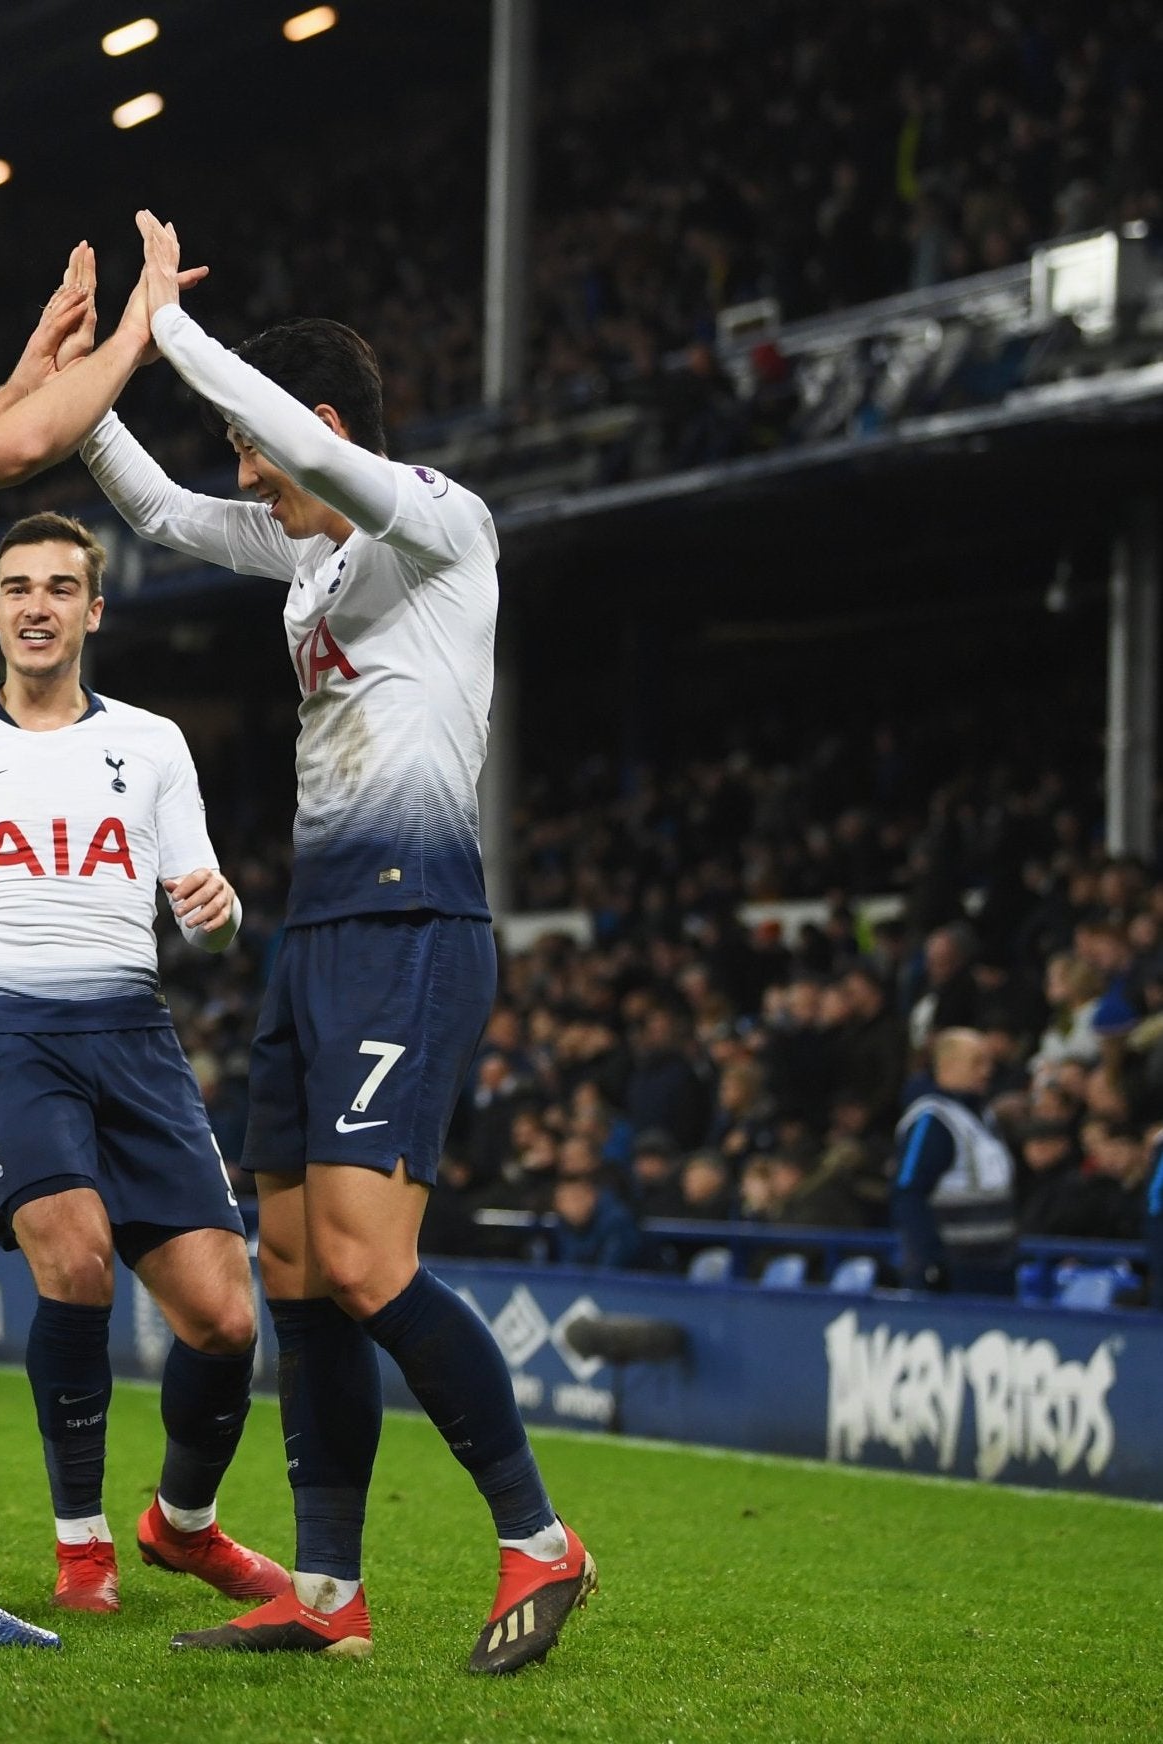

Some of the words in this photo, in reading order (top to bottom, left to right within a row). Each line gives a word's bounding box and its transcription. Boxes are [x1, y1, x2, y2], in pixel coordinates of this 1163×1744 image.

[350, 1040, 406, 1113] 7
[66, 1411, 103, 1428] SPURS
[824, 1309, 965, 1471] ANGRY
[965, 1328, 1117, 1482] BIRDS
